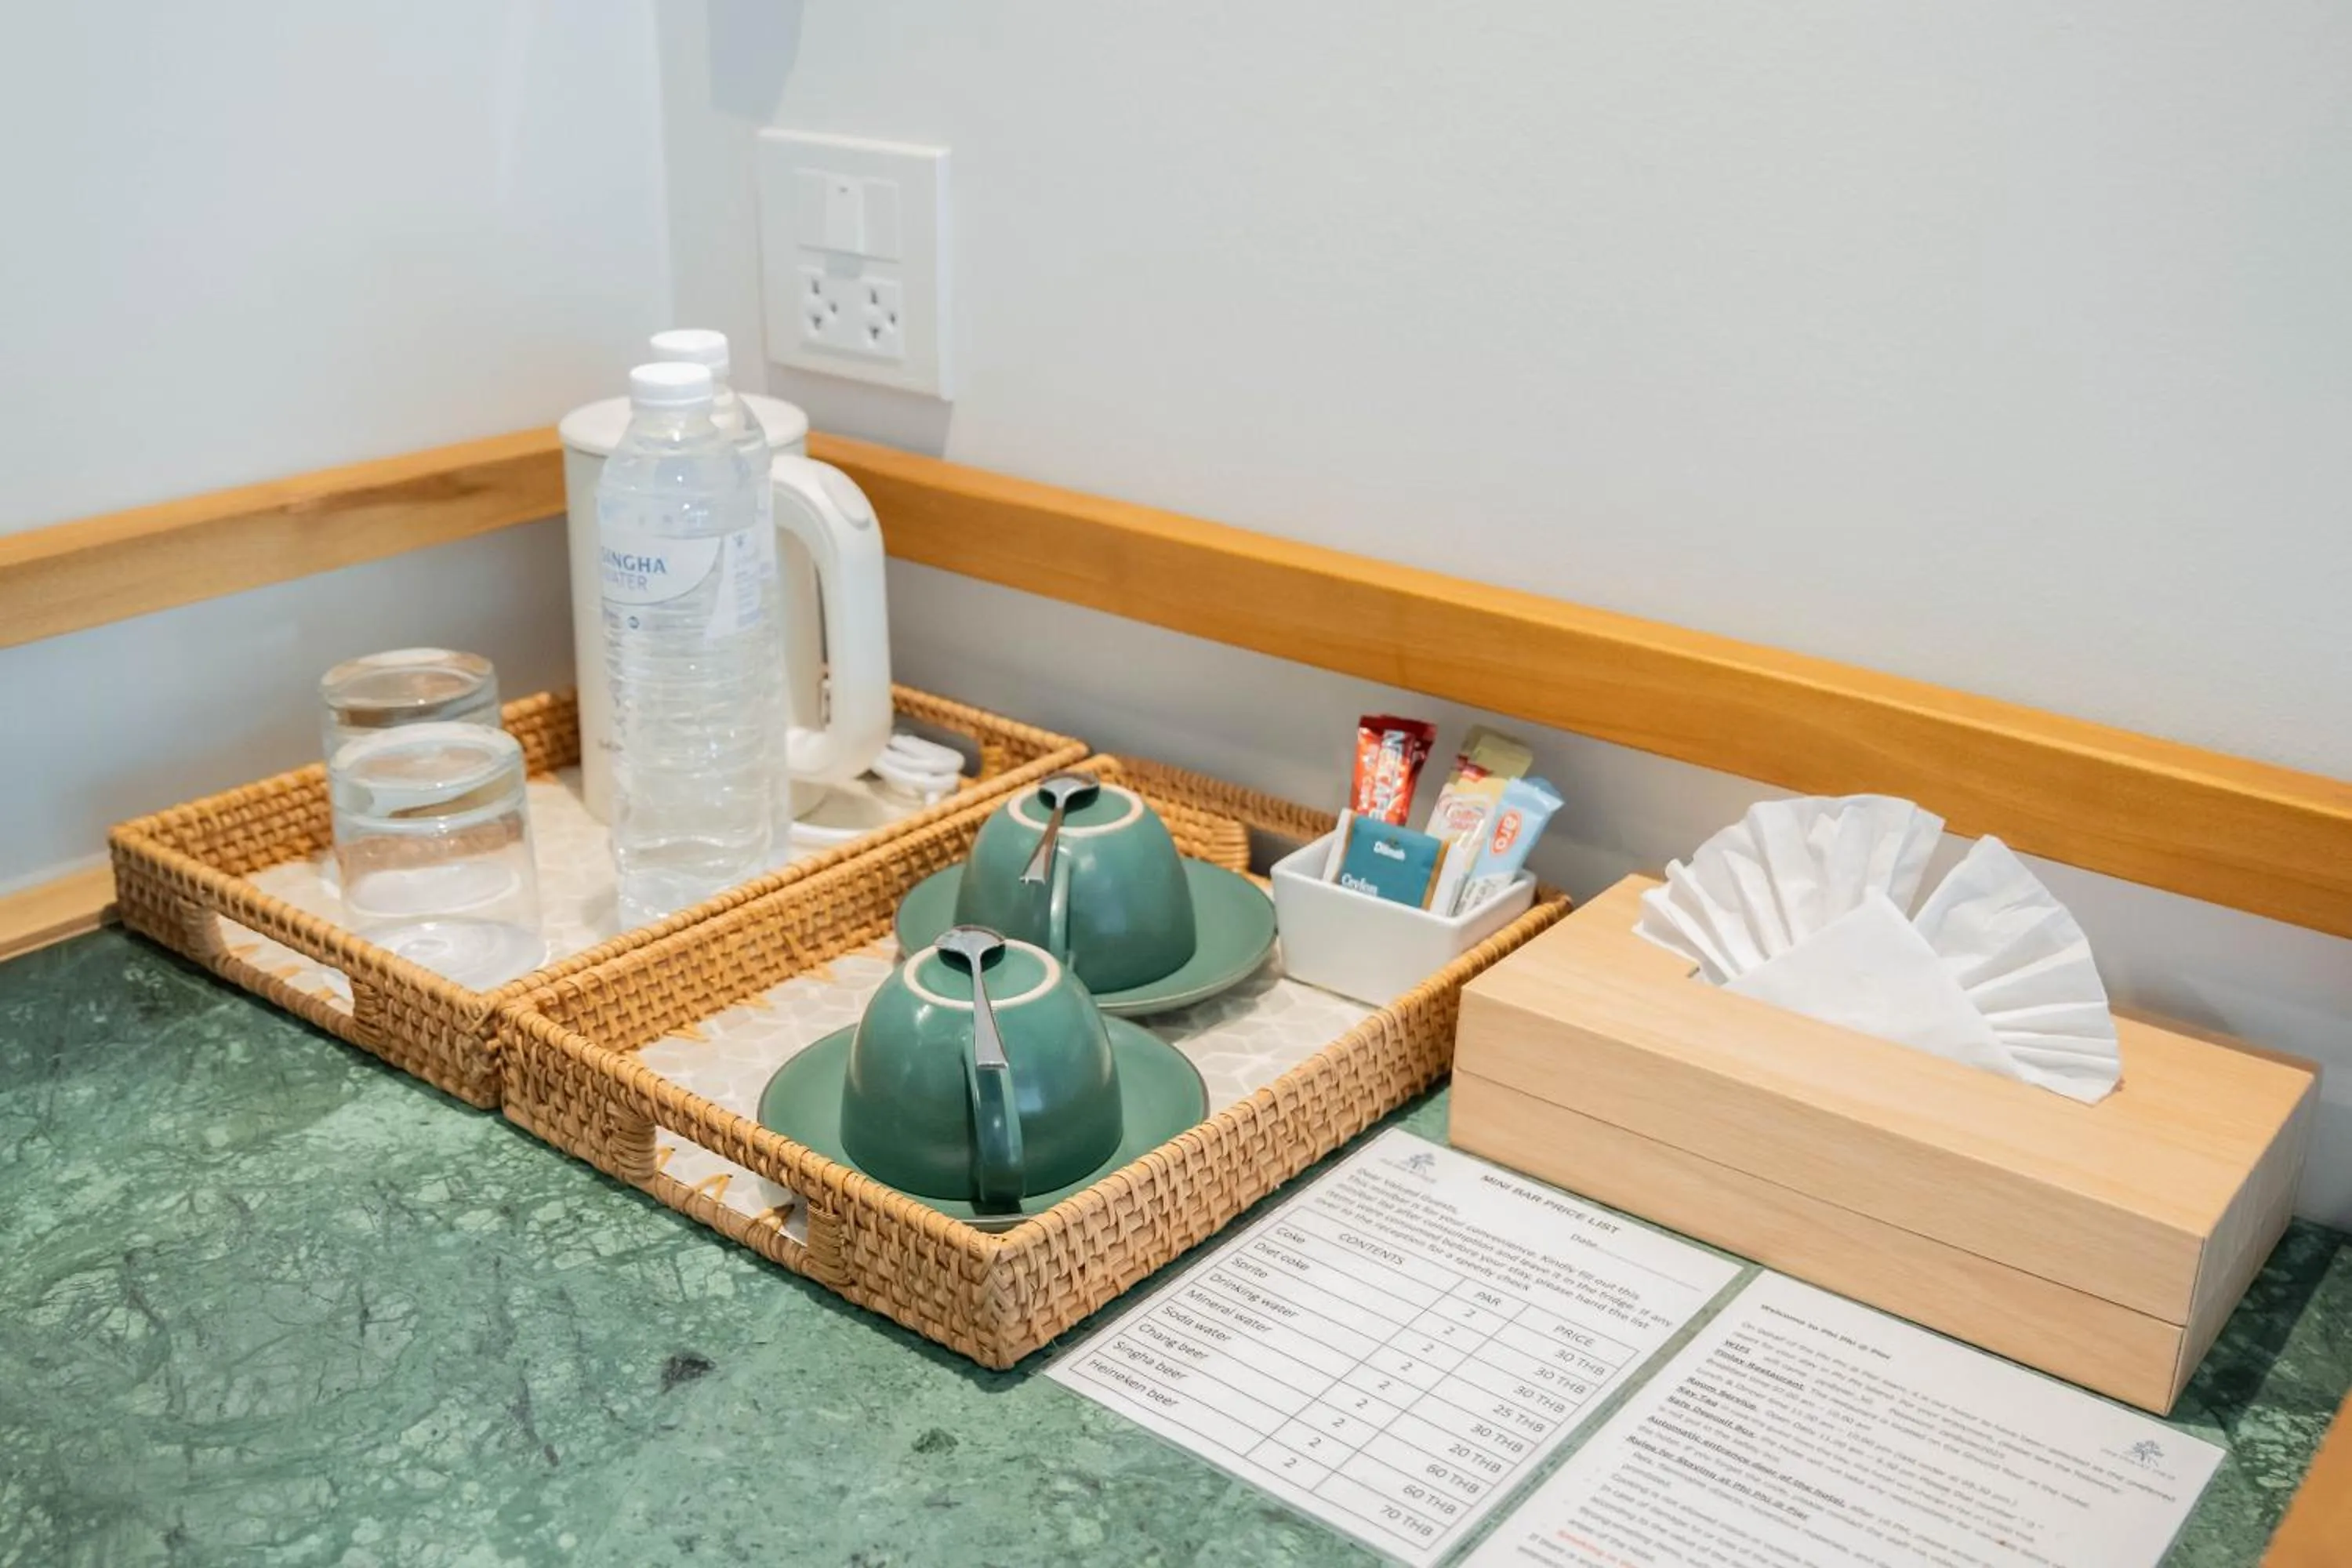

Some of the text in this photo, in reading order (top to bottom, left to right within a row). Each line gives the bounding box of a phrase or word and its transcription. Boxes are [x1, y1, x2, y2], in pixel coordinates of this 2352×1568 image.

[1480, 1174, 1621, 1234] MINI BAR PRICE LIST
[1275, 1226, 1305, 1244] Coke
[1338, 1232, 1405, 1265] CONTENTS
[1230, 1257, 1268, 1279] Sprite
[1253, 1241, 1310, 1272] Diet coke
[1208, 1272, 1299, 1318] Drinking water
[1473, 1290, 1502, 1307] PAR
[1160, 1305, 1232, 1341] Soda water
[1185, 1289, 1272, 1332] Mineral water
[1462, 1307, 1477, 1319] 2
[1138, 1323, 1209, 1359] Chang beer
[1442, 1325, 1456, 1336] 2
[1552, 1324, 1595, 1348] PRICE
[1112, 1340, 1188, 1380] Singha beer
[1420, 1343, 1435, 1353] 2
[1554, 1348, 1606, 1377] 30 THB
[1399, 1360, 1414, 1372] 2
[1533, 1366, 1587, 1396] 30 THB
[1087, 1358, 1179, 1406] Heineken beer
[1377, 1379, 1392, 1391] 2
[1354, 1398, 1369, 1410] 2
[1512, 1385, 1566, 1414] 30 THB
[1330, 1417, 1346, 1428] 2
[1491, 1403, 1545, 1433] 25 THB
[1307, 1436, 1322, 1449] 2
[1469, 1422, 1524, 1454] 30 THB
[1282, 1456, 1298, 1469] 2
[1447, 1443, 1502, 1474] 20 THB
[1425, 1463, 1480, 1494] 60 THB
[1402, 1483, 1457, 1515] 60 THB
[1379, 1504, 1434, 1537] 70 THB
